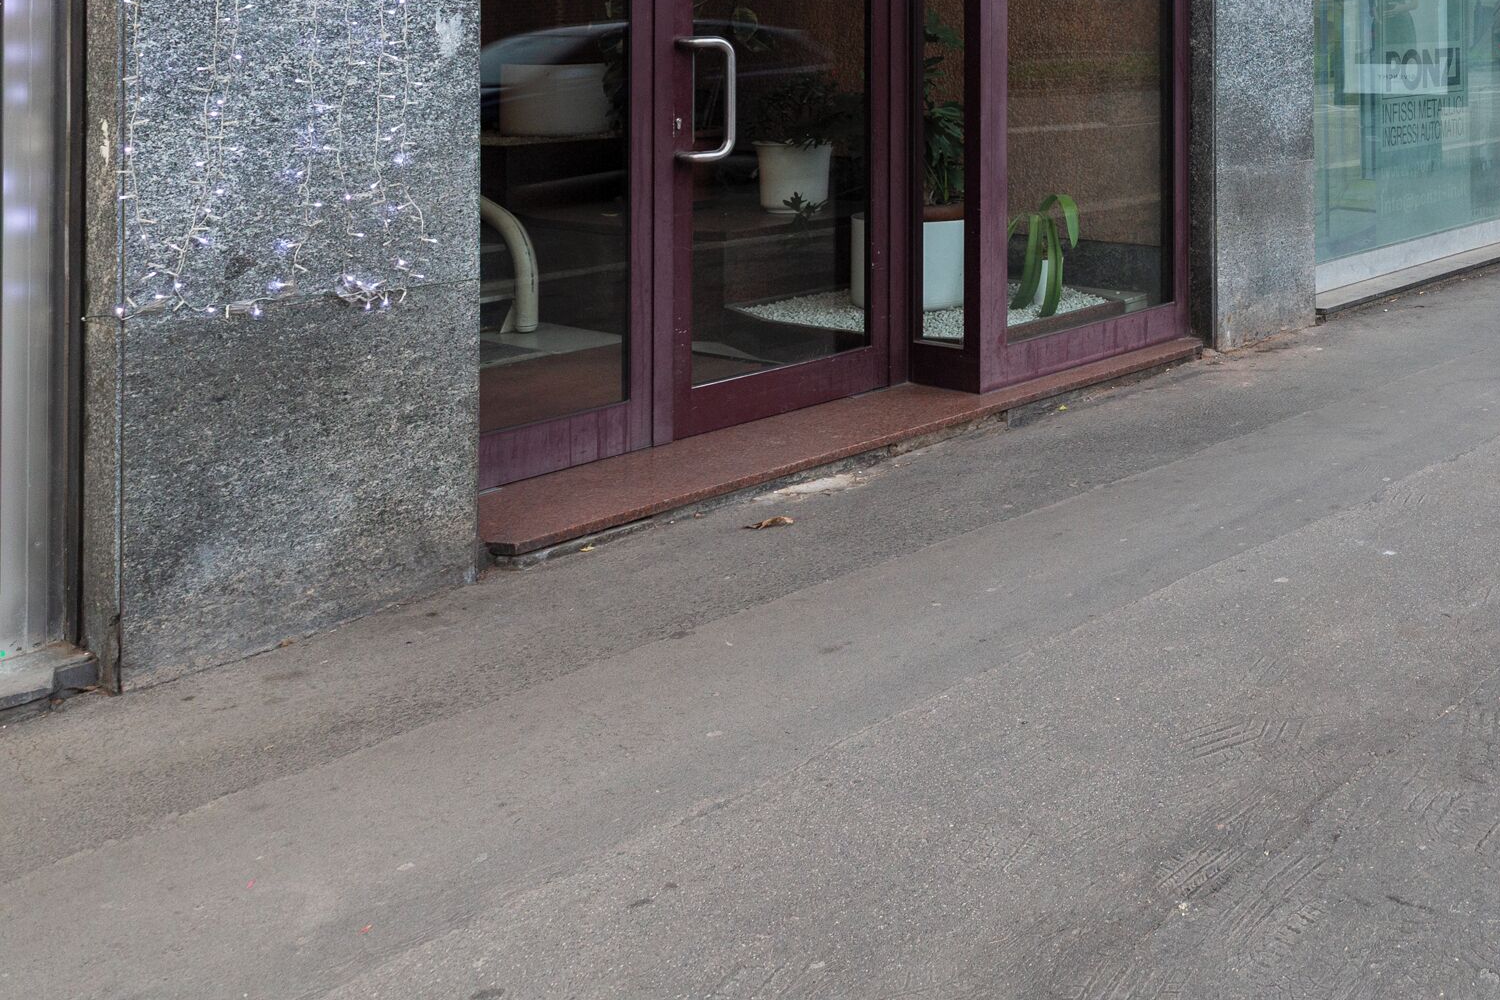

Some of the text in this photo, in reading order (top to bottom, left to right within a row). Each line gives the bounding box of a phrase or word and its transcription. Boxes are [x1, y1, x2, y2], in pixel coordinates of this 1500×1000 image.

[1386, 49, 1460, 92] PONZI
[1383, 96, 1464, 124] INFISSI METALLICI
[1383, 124, 1419, 147] INGRESSI
